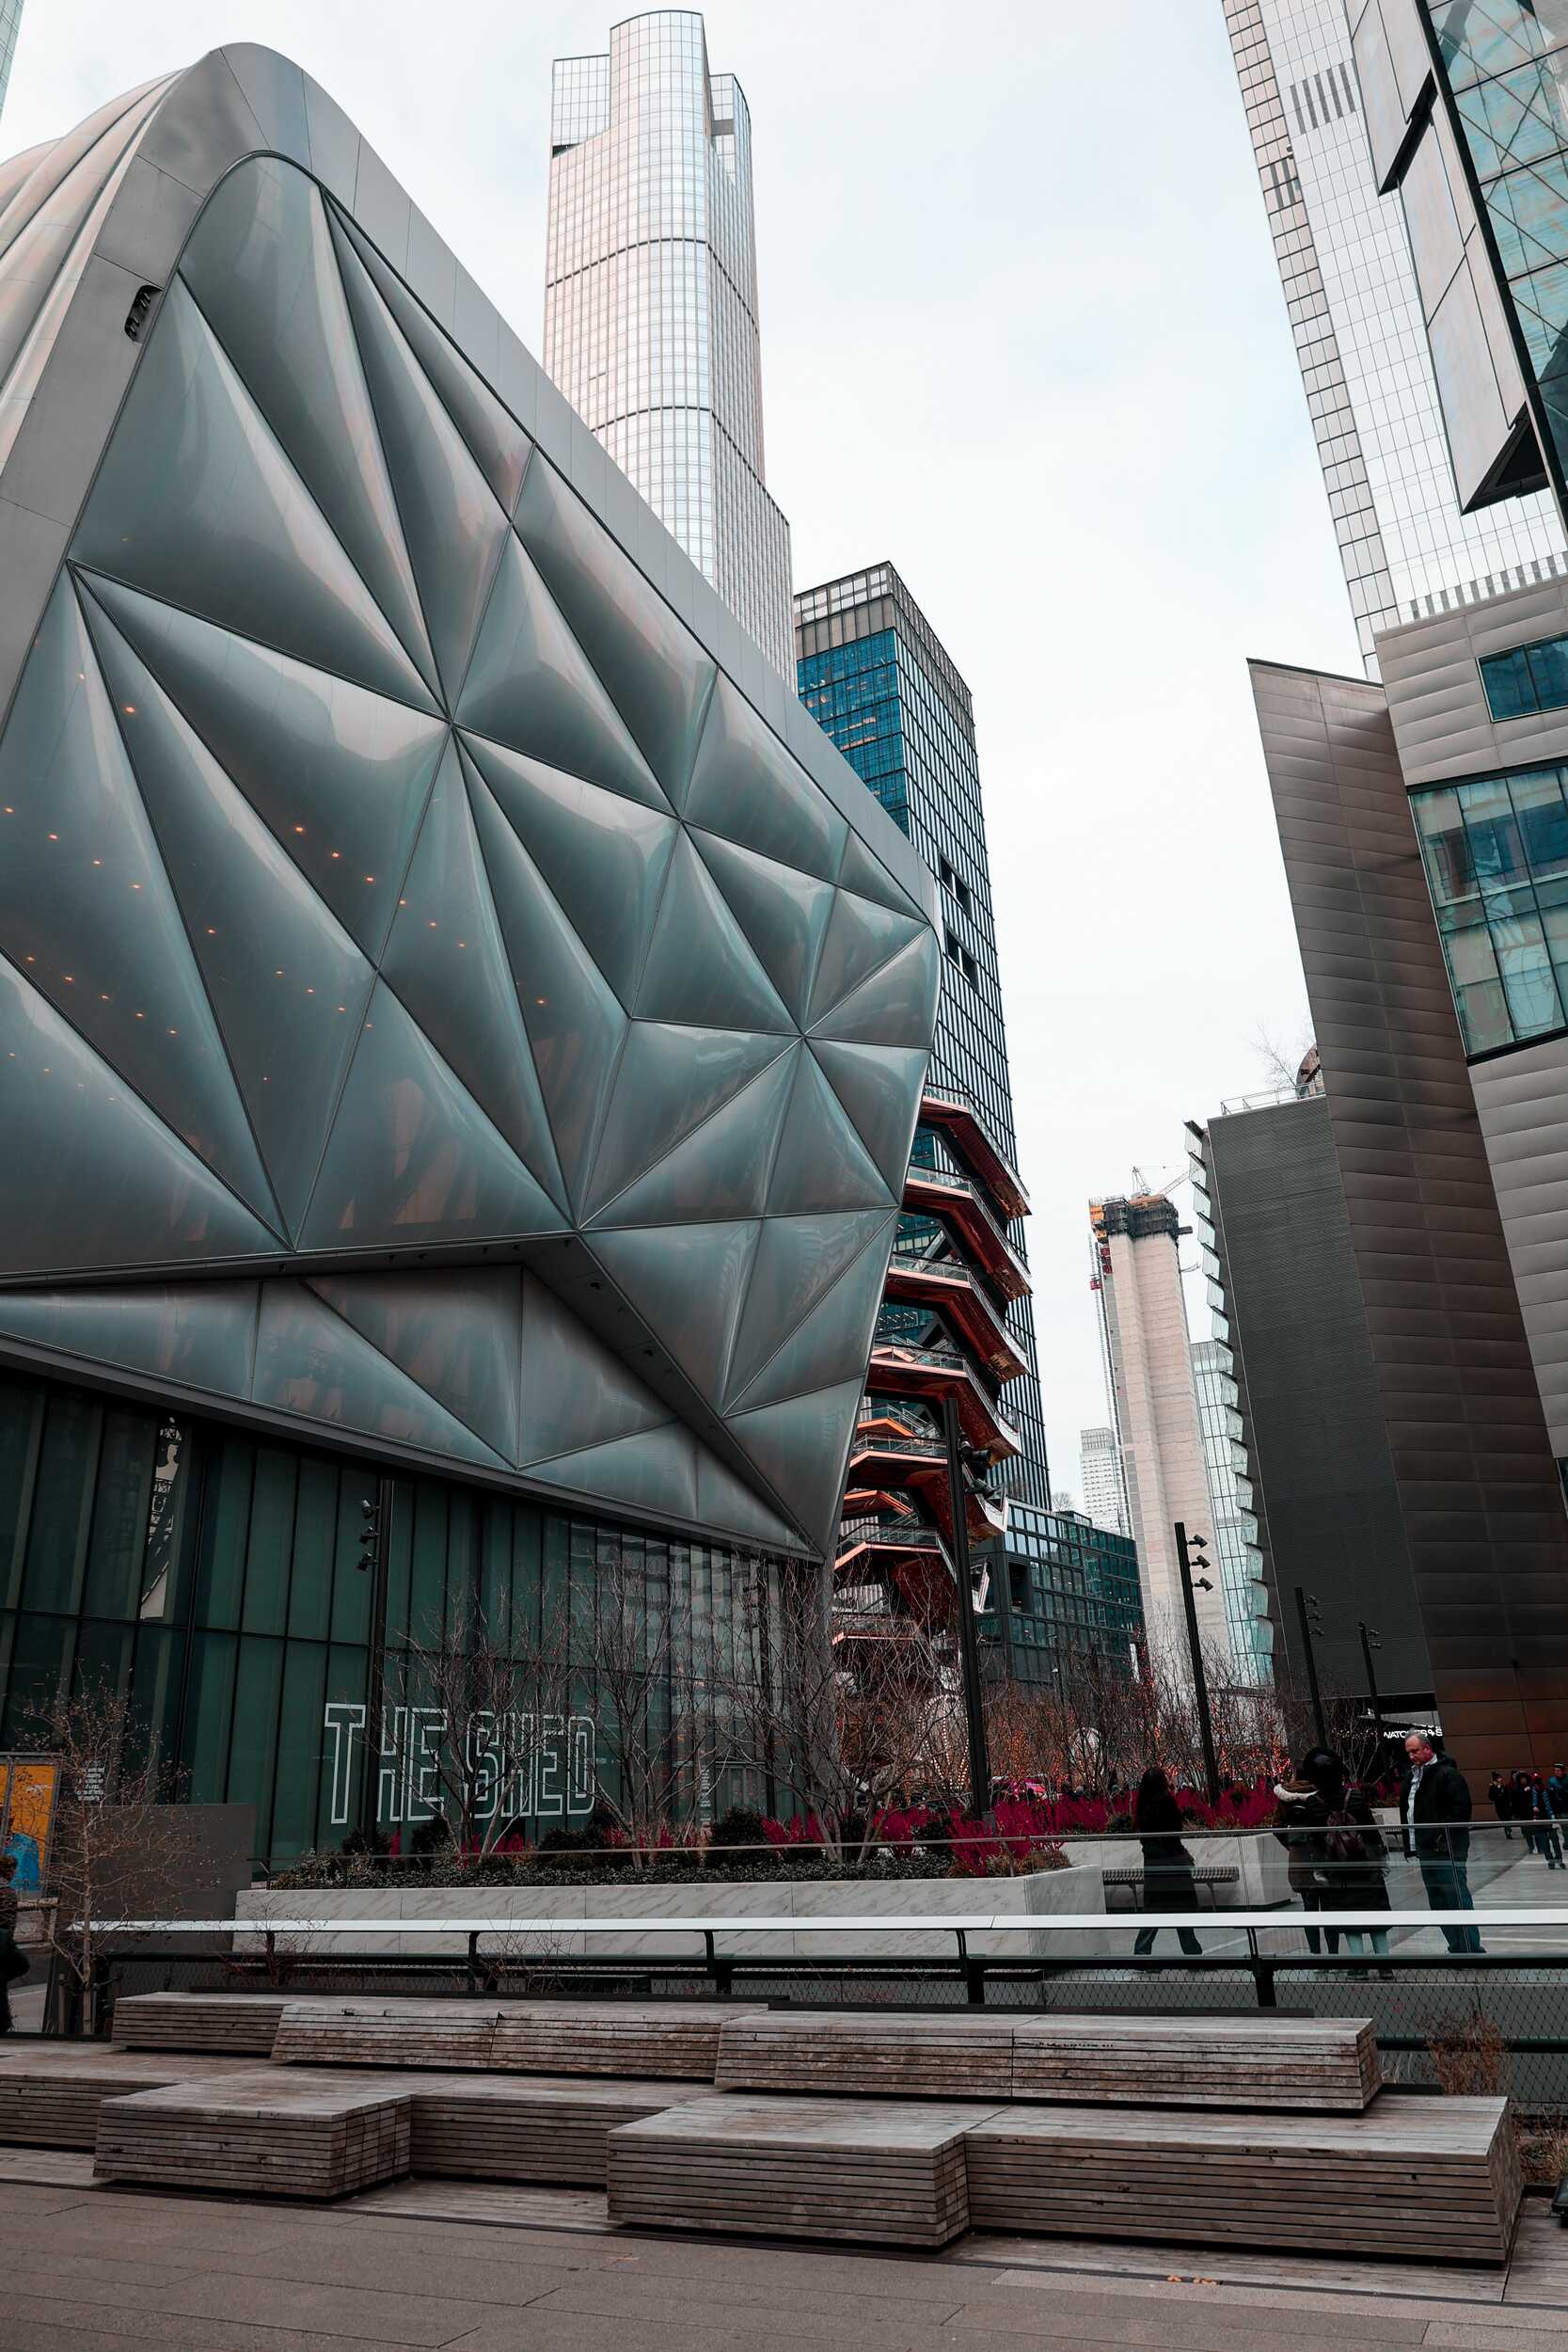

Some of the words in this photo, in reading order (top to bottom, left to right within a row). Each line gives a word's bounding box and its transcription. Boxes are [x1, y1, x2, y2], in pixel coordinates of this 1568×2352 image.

[325, 1703, 448, 1824] THE
[466, 1710, 595, 1819] SHED
[1384, 1729, 1427, 1739] WATCS
